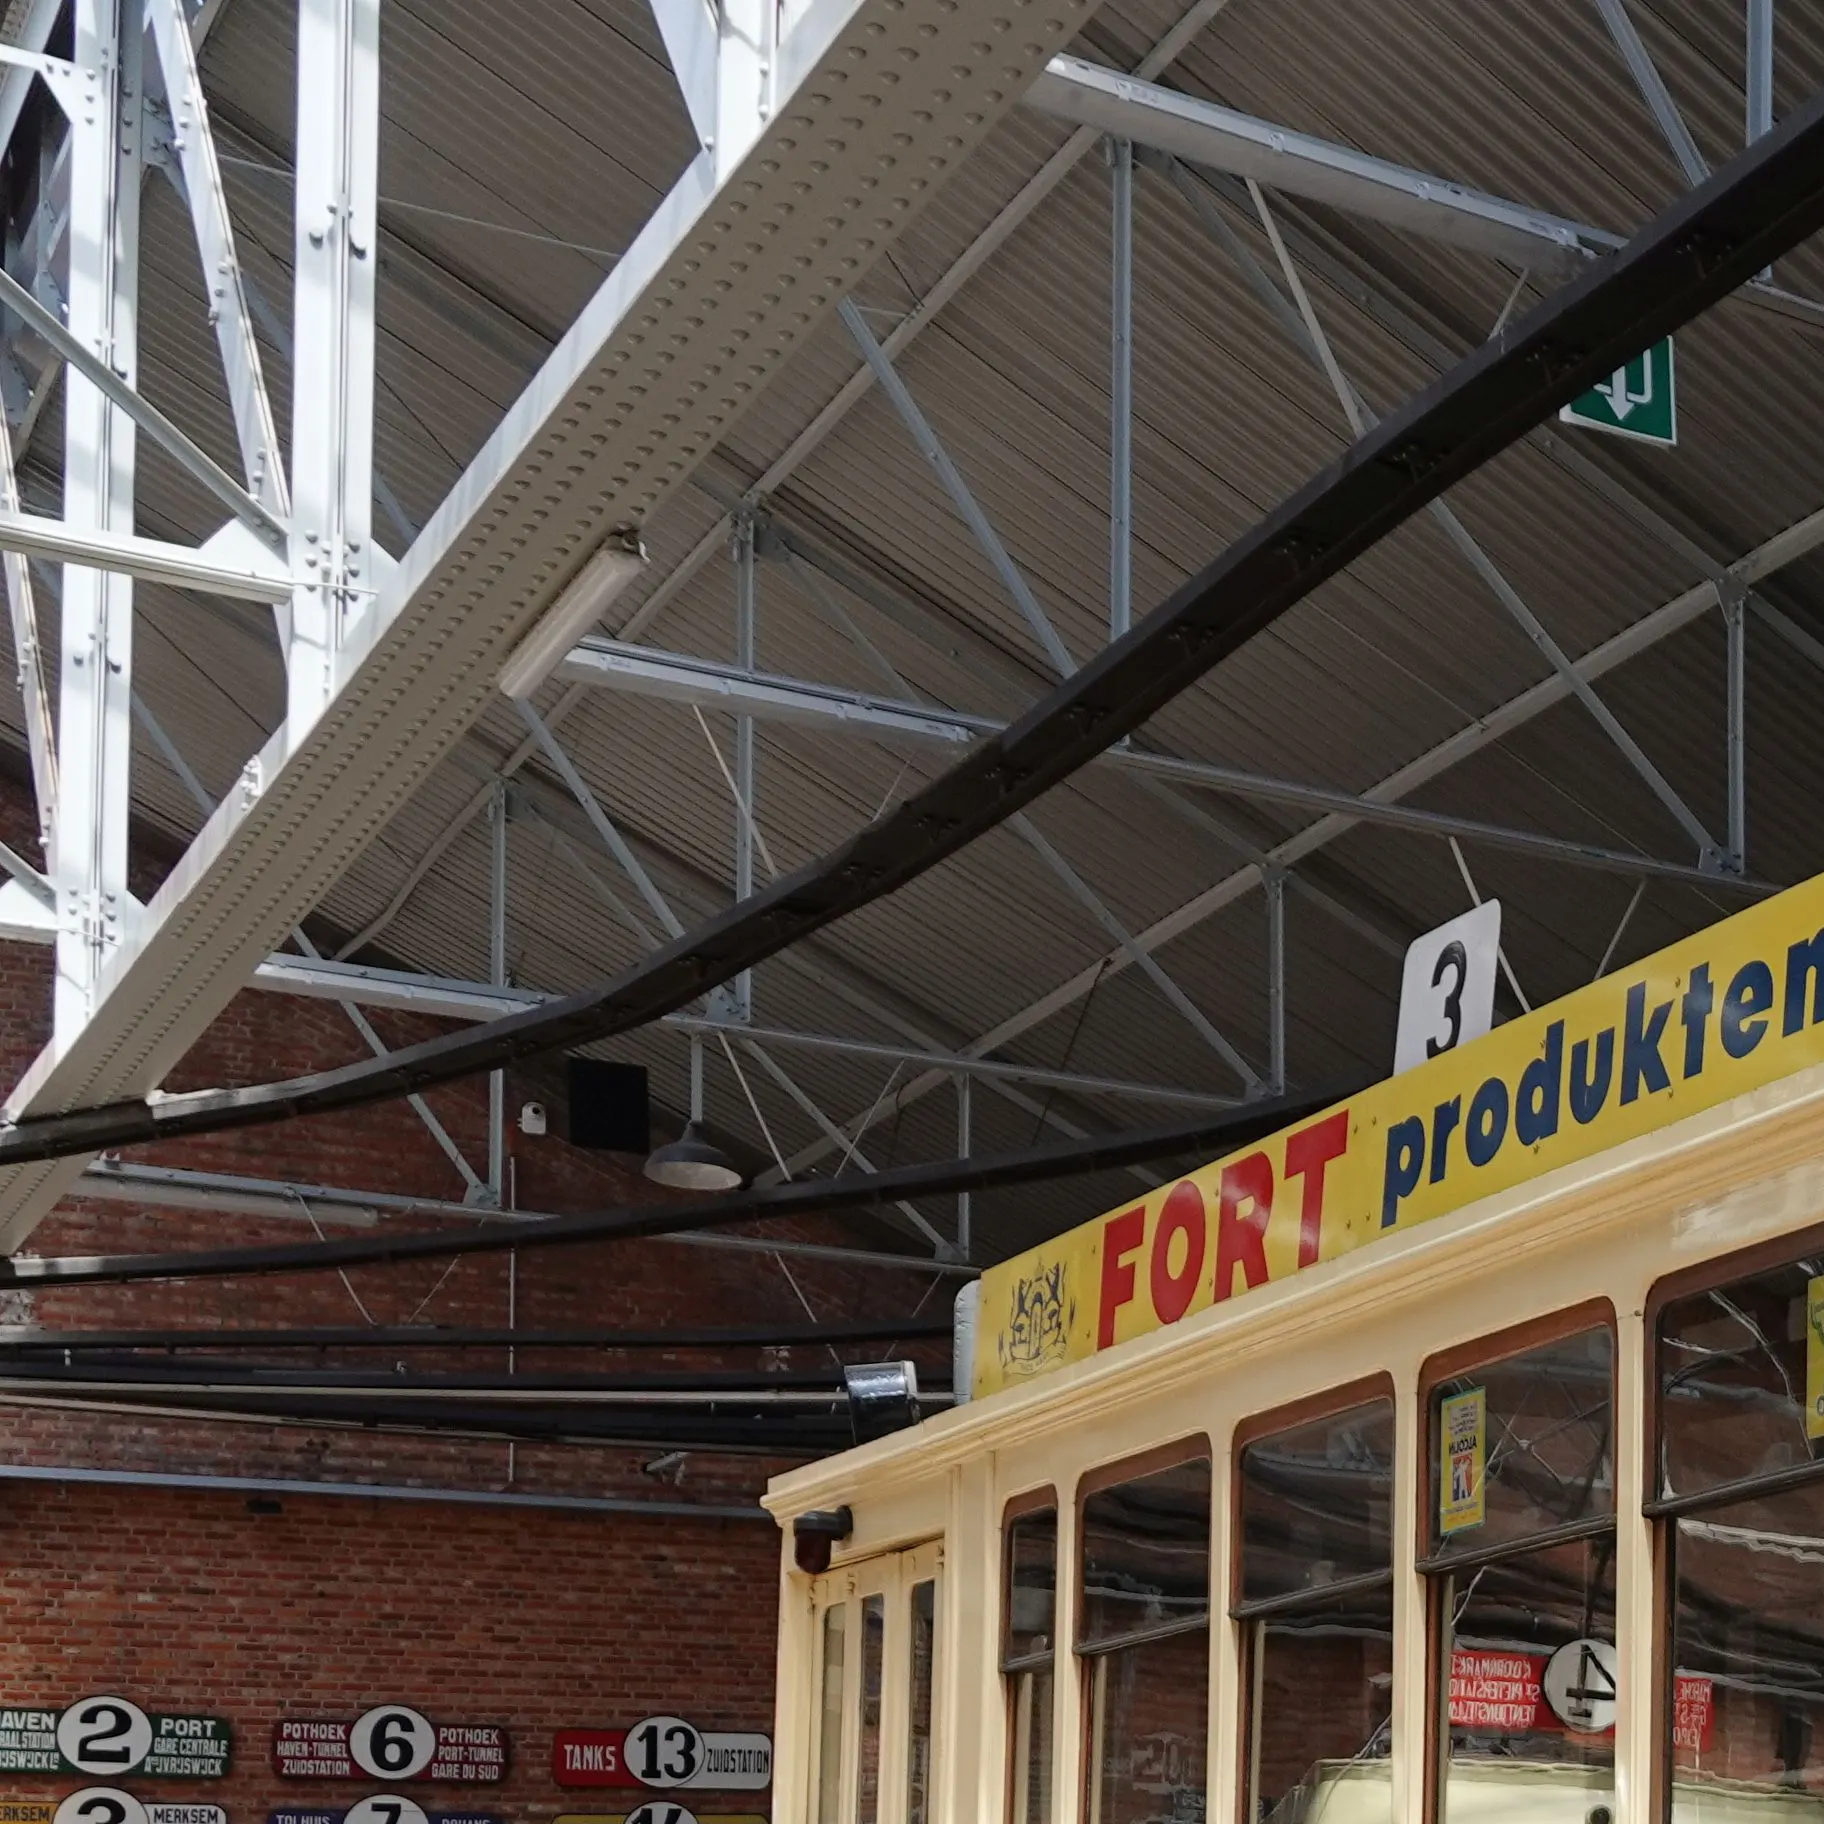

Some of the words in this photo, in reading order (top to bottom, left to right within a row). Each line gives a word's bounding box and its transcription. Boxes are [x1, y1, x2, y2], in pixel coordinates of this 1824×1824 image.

[1426, 939, 1467, 1060] 3
[1097, 1108, 1349, 1352] FORT
[0, 1711, 55, 1730] AVEN
[160, 1718, 216, 1737] PORT
[78, 1704, 132, 1763] 2
[283, 1723, 346, 1739] POTHOEK
[439, 1728, 499, 1744] POTHOEK
[153, 1737, 178, 1755] GARE
[179, 1738, 228, 1757] CENTRALE
[370, 1713, 415, 1771] 6
[637, 1725, 696, 1779] 13
[282, 1759, 350, 1775] ZUIDSTATION
[564, 1745, 616, 1771] TANKS
[706, 1749, 769, 1774] ZUIDSTATION
[432, 1763, 461, 1779] GARE
[462, 1764, 476, 1779] DU
[478, 1764, 499, 1780] SUD
[154, 1808, 218, 1824] MERKSEM
